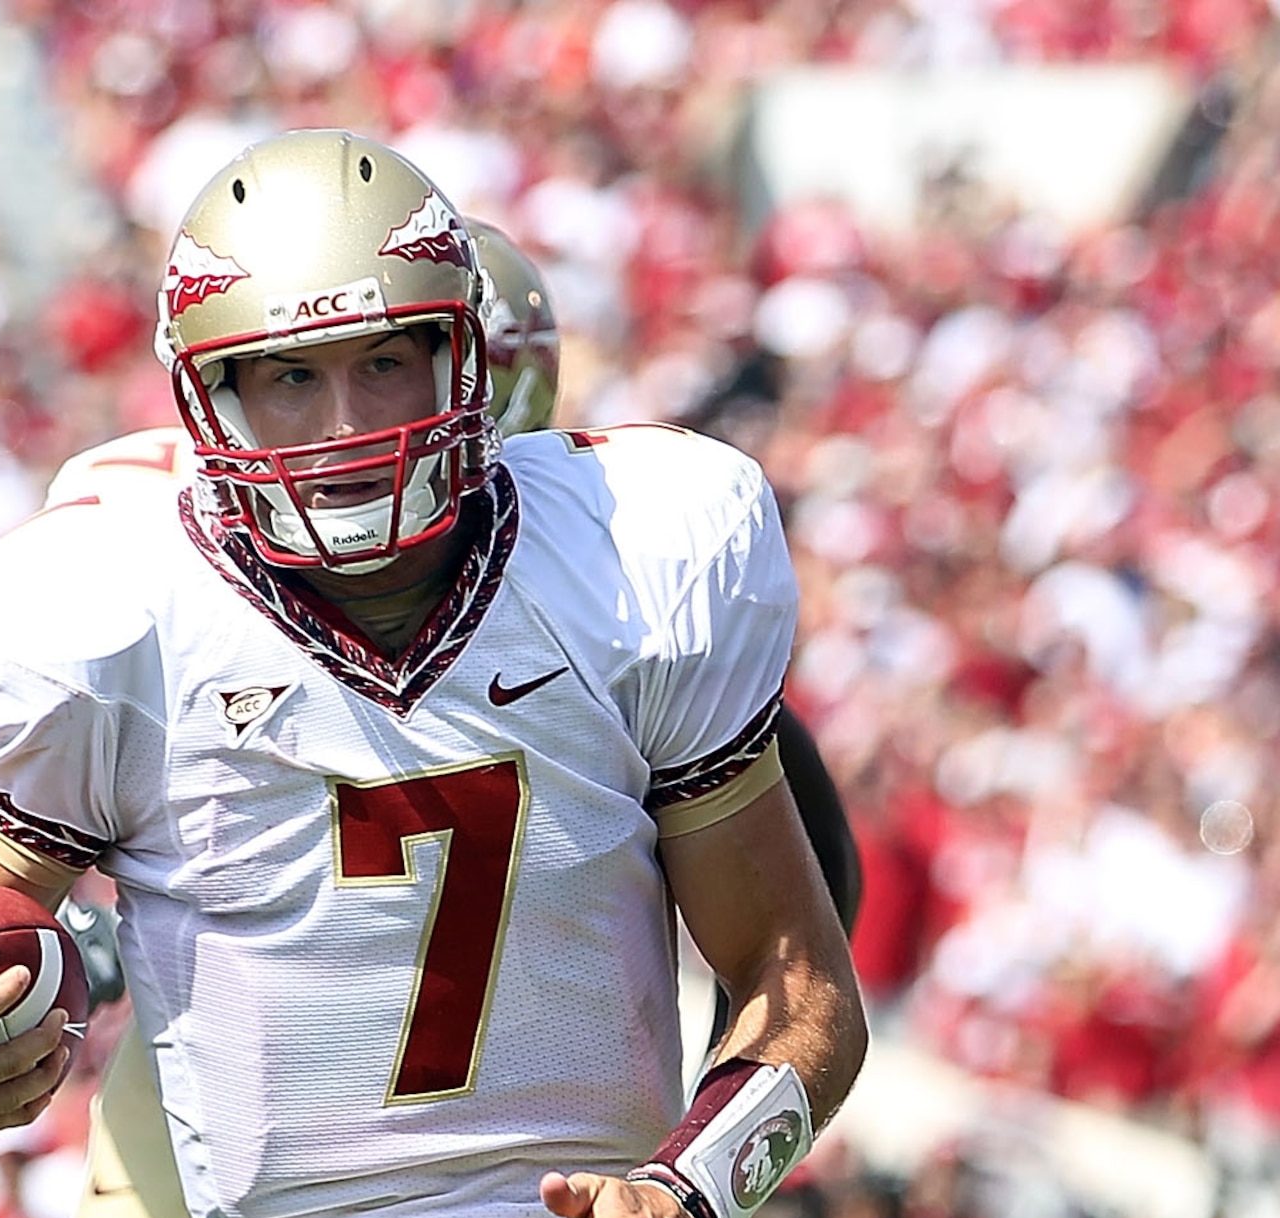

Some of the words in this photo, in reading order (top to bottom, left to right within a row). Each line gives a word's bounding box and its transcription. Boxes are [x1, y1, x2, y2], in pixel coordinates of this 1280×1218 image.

[291, 292, 348, 321] ACC
[332, 529, 379, 546] Riddell
[236, 700, 261, 716] ACC
[324, 750, 531, 1108] 7
